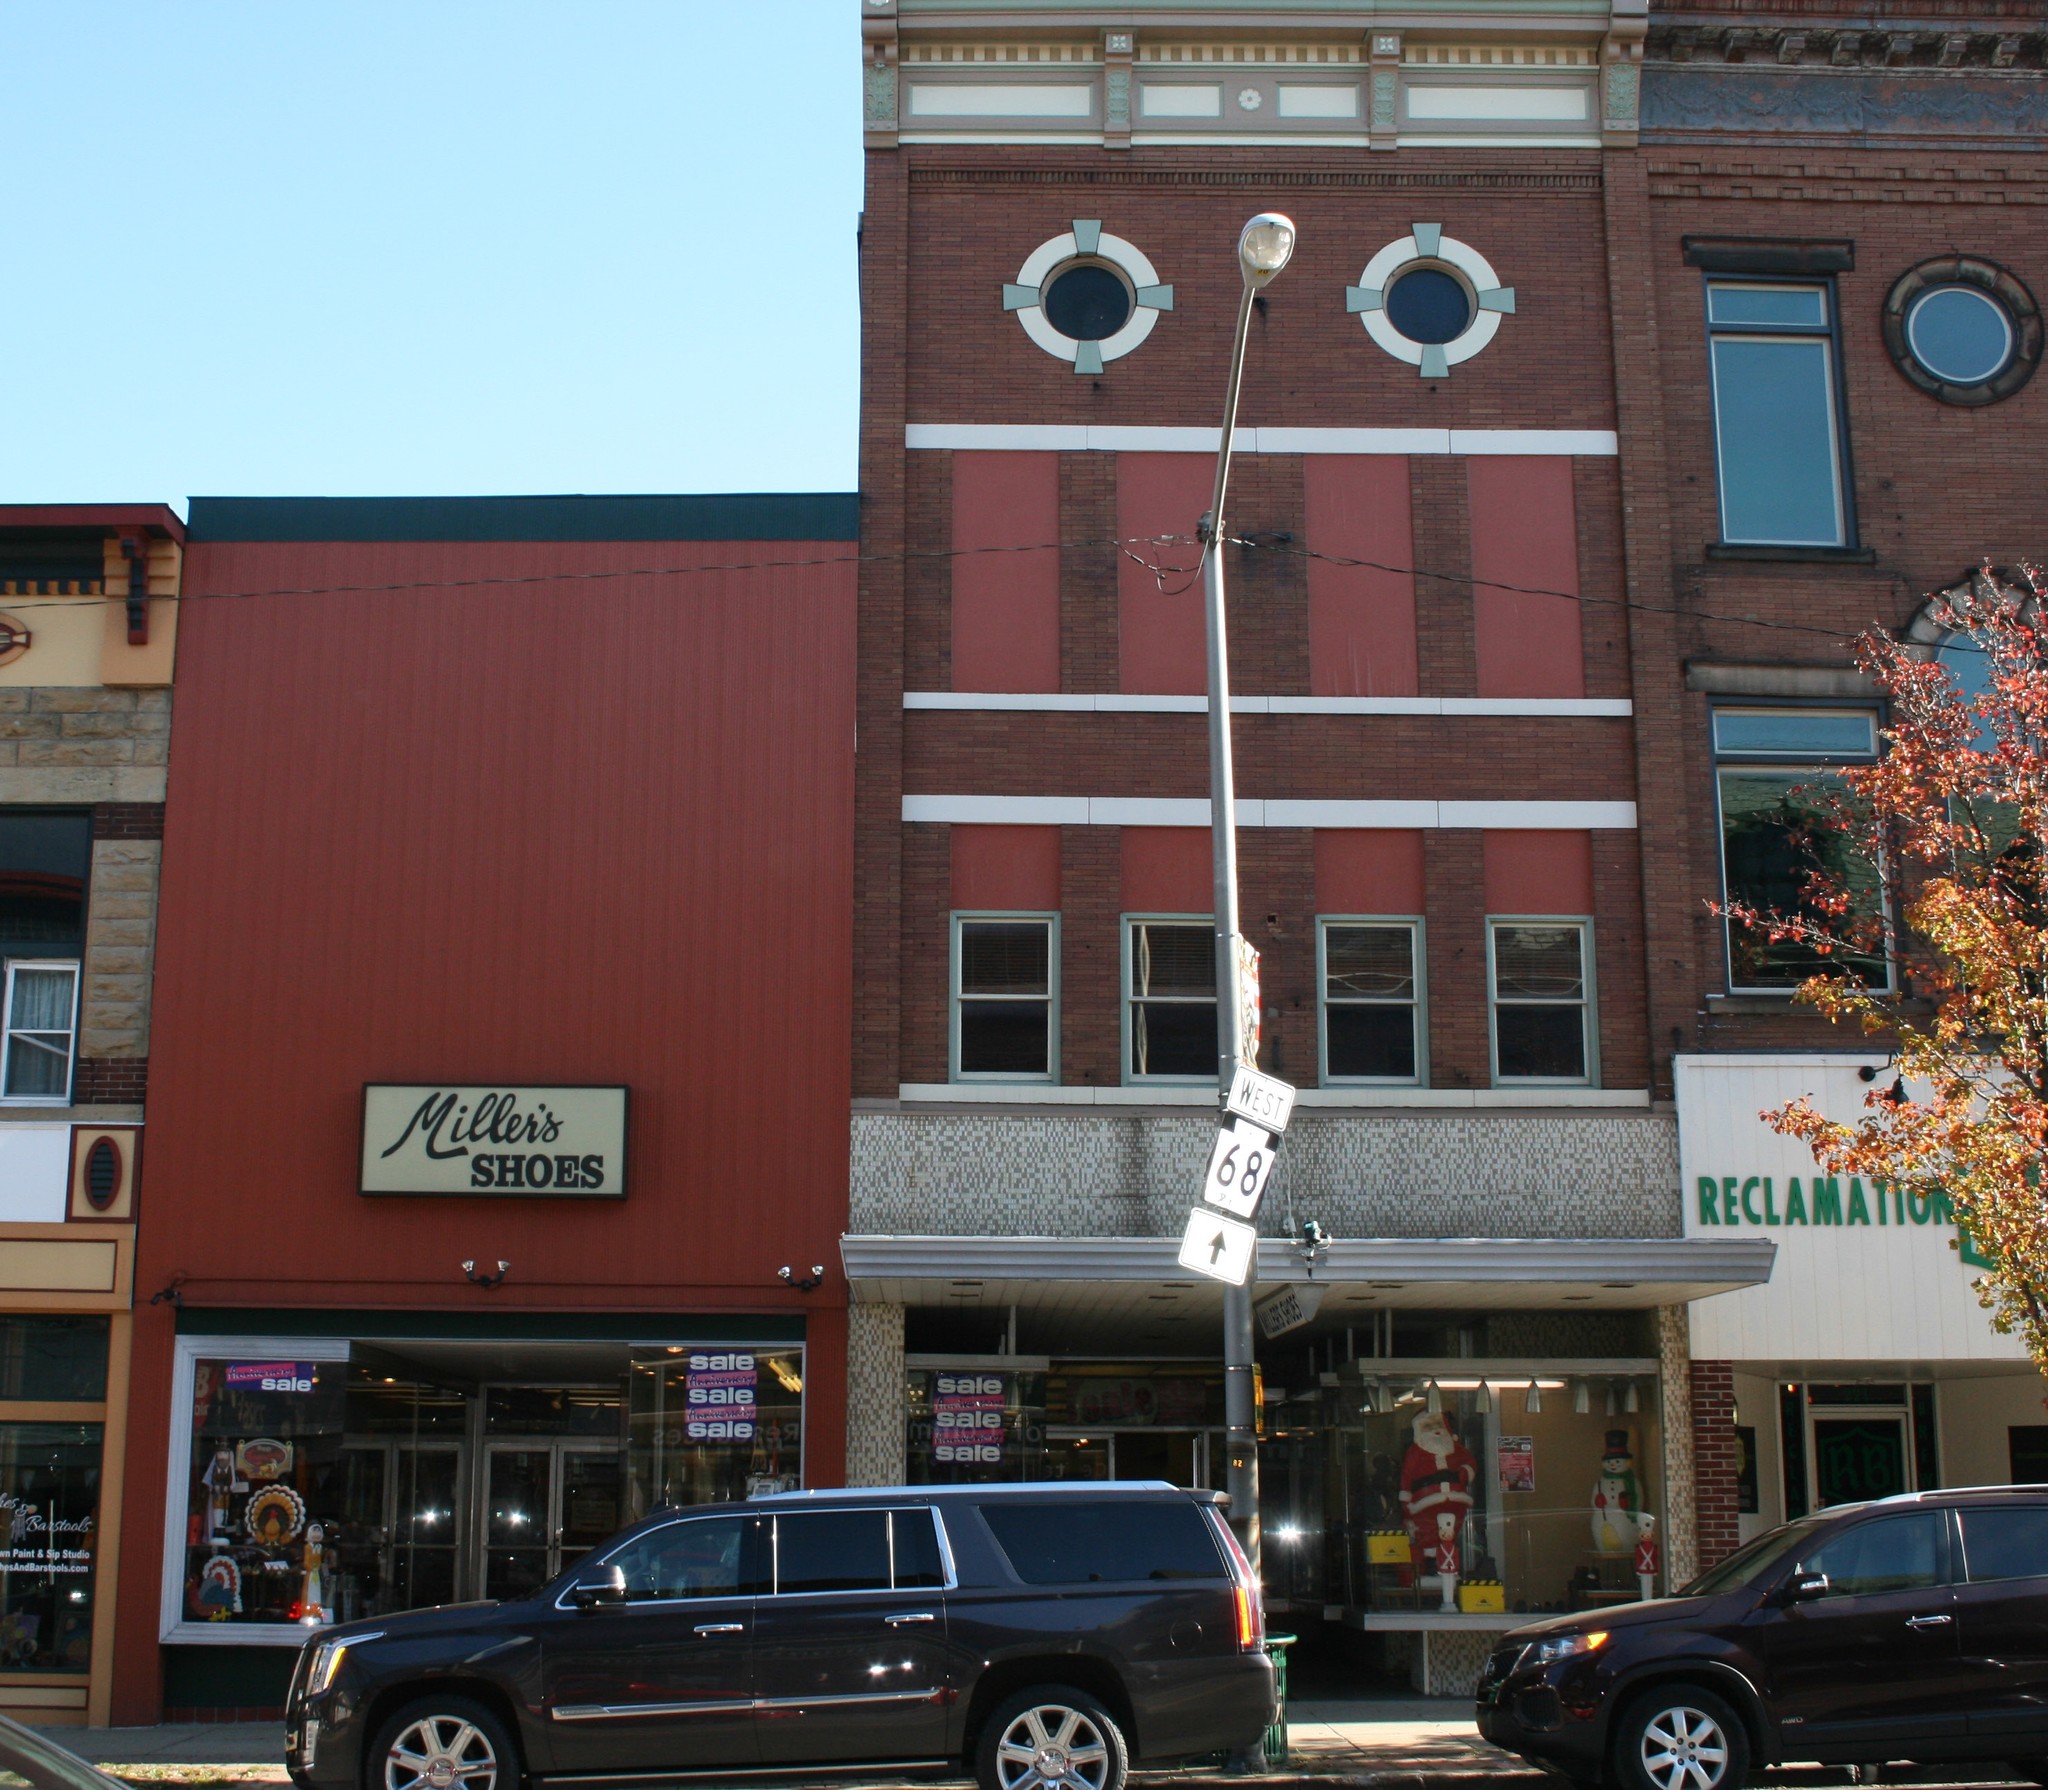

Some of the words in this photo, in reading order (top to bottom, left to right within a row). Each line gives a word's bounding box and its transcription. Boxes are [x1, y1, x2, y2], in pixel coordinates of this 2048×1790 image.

[1239, 1077, 1284, 1120] WEST
[380, 1091, 564, 1160] Miller's
[470, 1153, 605, 1189] SHOES
[1216, 1144, 1263, 1197] 68
[1697, 1176, 1956, 1226] RECLAMATION
[689, 1353, 755, 1371] sale
[261, 1376, 312, 1392] sale
[688, 1373, 755, 1387] Anniversary
[937, 1376, 1003, 1395] sale
[688, 1386, 754, 1405] sale
[936, 1410, 1001, 1429] sale
[687, 1420, 753, 1439] sale
[935, 1444, 1001, 1463] sale
[26, 1515, 92, 1532] Barstools
[13, 1548, 35, 1558] Paint
[37, 1549, 44, 1558] &
[46, 1549, 60, 1561] Sip
[62, 1549, 90, 1559] Studio
